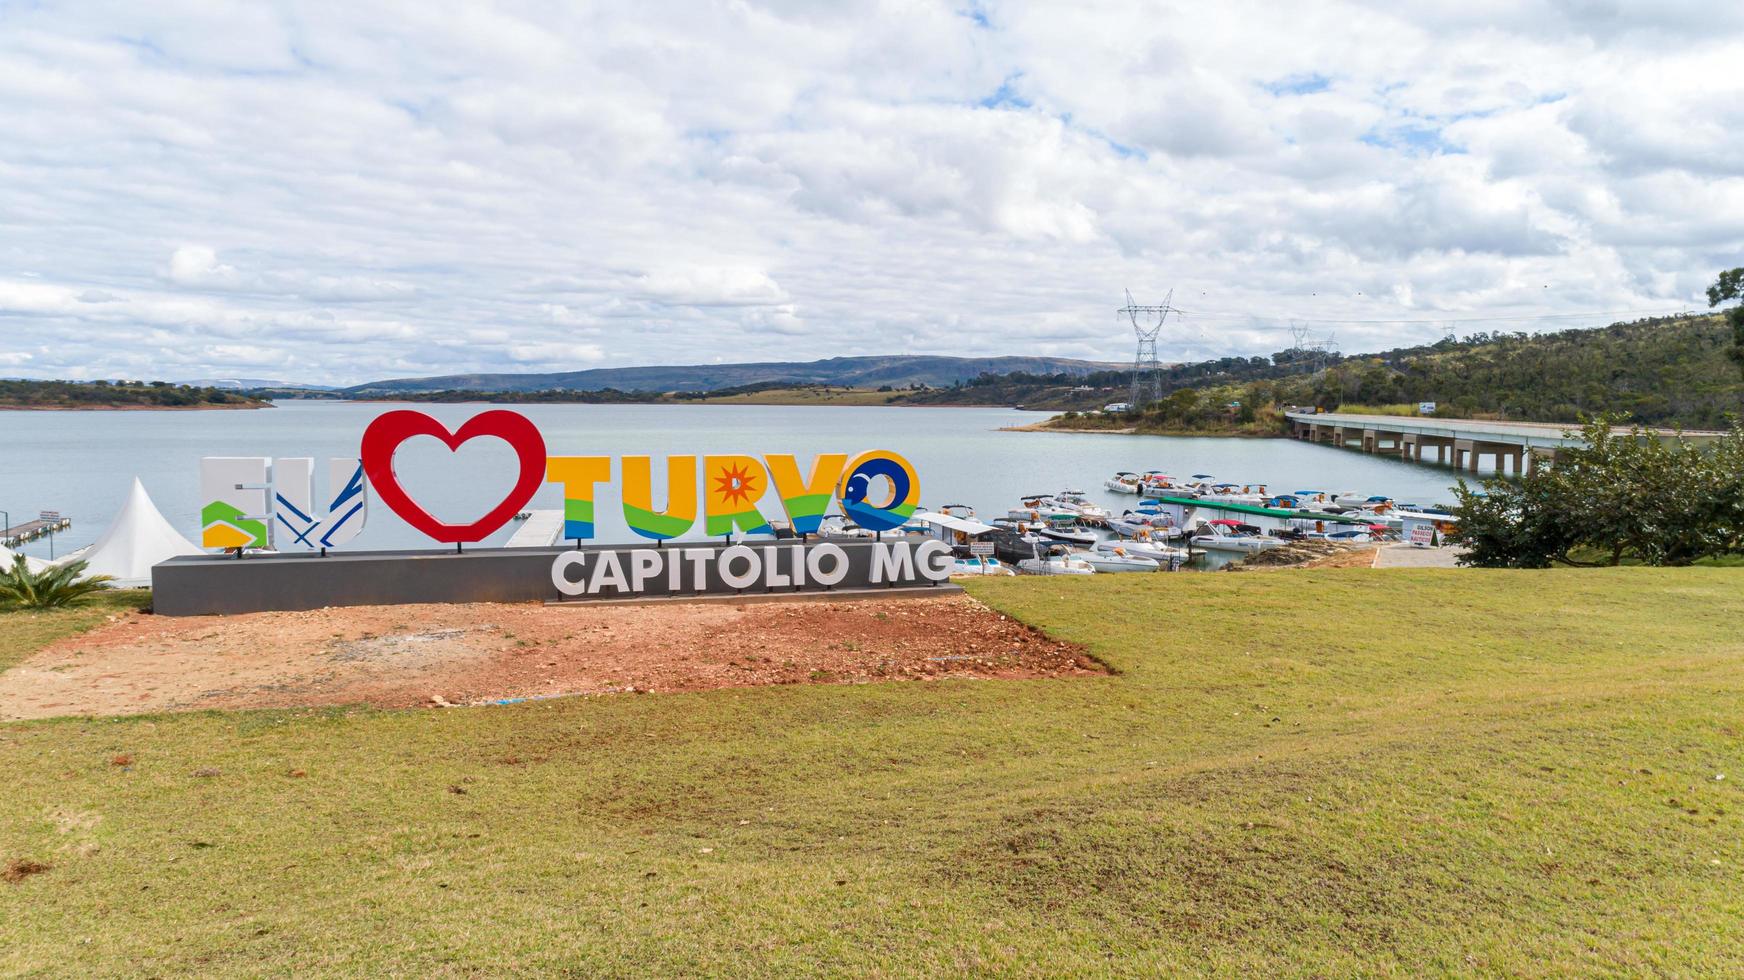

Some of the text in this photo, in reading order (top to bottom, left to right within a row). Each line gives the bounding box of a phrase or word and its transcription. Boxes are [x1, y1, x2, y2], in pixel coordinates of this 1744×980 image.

[201, 449, 921, 549] EU TURVO
[551, 531, 956, 596] CAPITÓLIO MG
